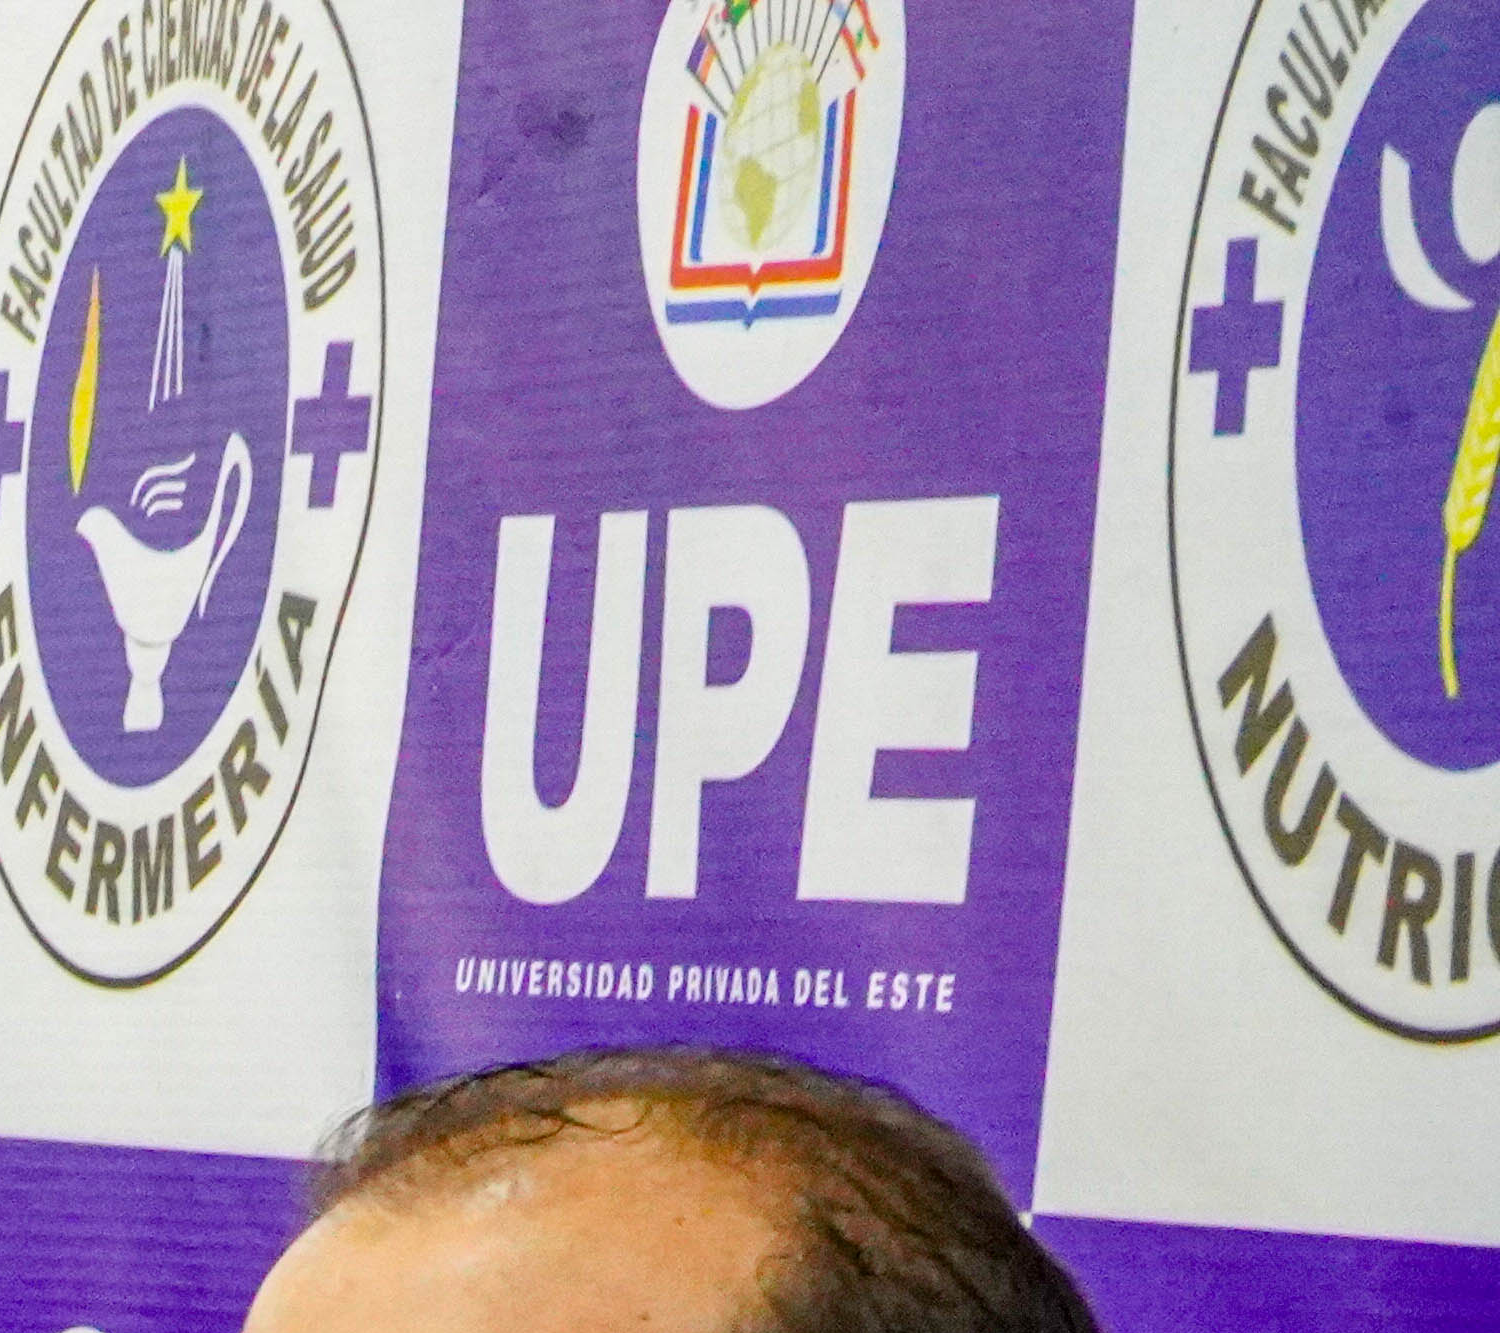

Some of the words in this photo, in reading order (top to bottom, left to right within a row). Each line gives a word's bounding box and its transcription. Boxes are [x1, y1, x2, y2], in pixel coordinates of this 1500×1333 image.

[102, 15, 136, 135] DE
[237, 2, 289, 119] DE
[263, 43, 317, 167] LA
[0, 72, 101, 344] FACULTAD
[284, 111, 356, 311] SALUD
[482, 497, 998, 903] UPE
[1217, 611, 1500, 986] NUTRI
[455, 957, 653, 999] UNIVERSIDAD
[668, 966, 780, 1003] PRIVADA
[793, 969, 849, 1007] DEL
[866, 971, 956, 1012] ESTE
